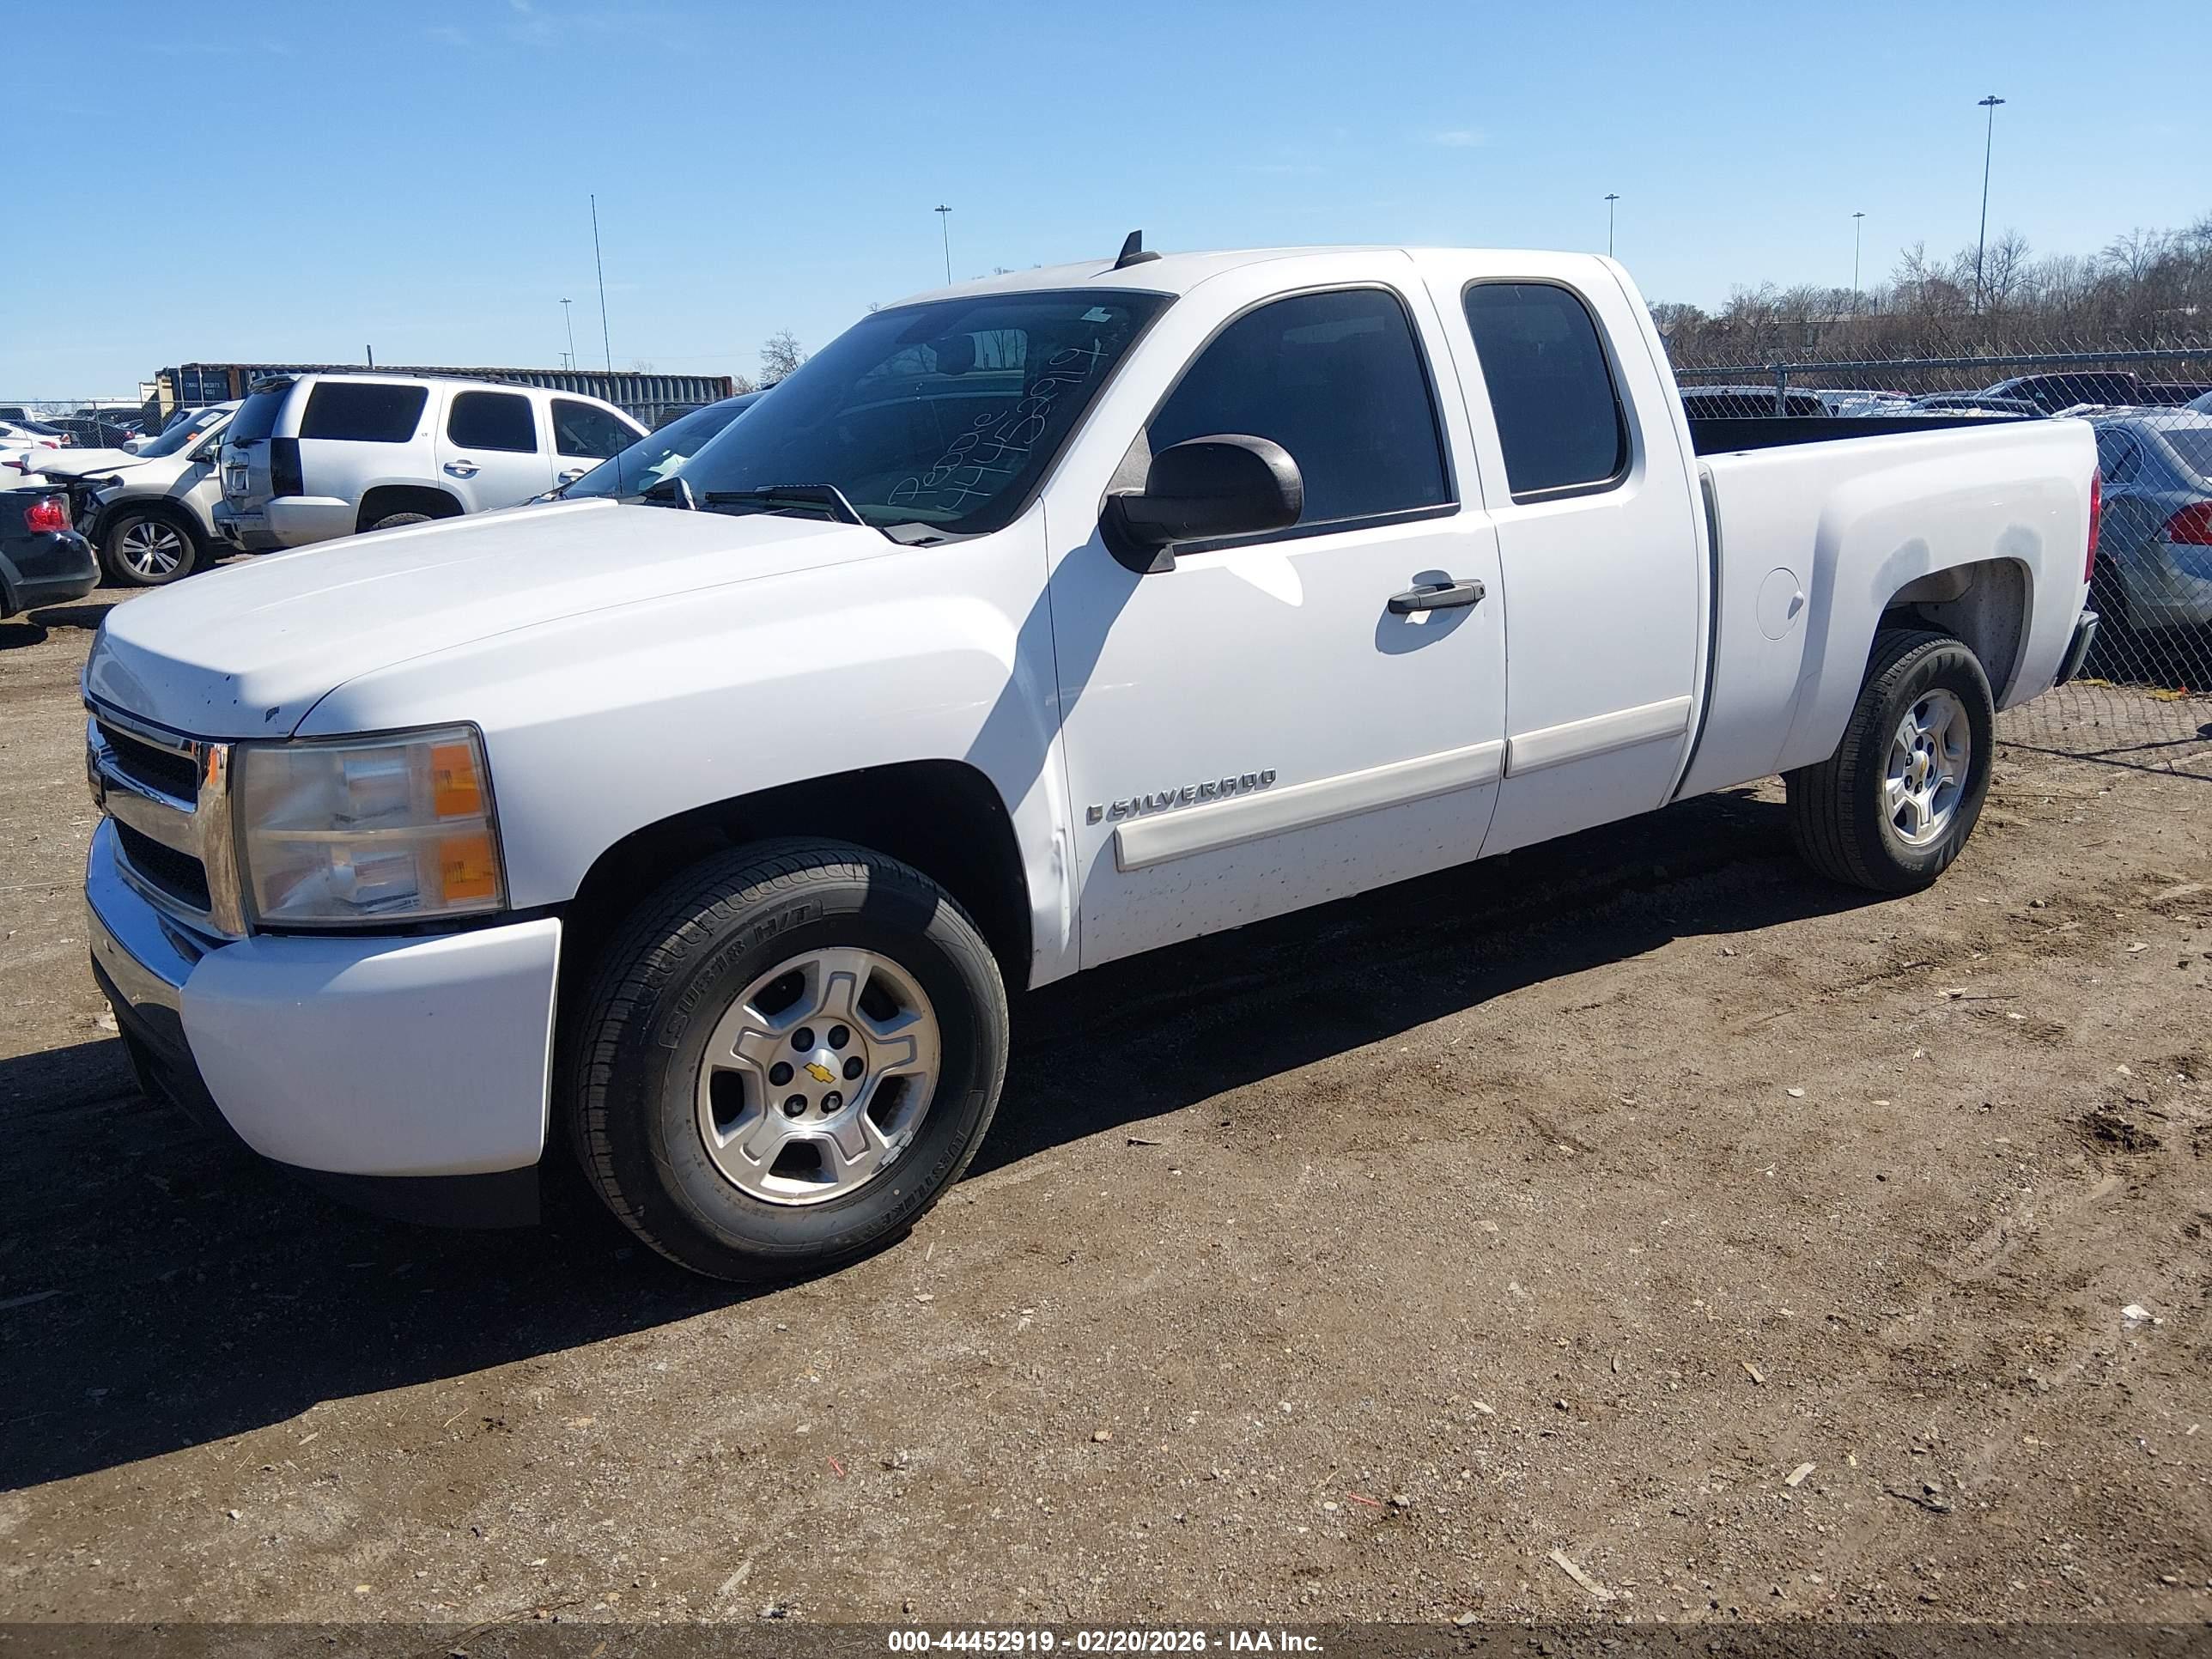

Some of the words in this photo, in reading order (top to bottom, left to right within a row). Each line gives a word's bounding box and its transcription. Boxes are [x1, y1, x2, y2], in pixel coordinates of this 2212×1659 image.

[933, 348, 1109, 511] 44452919
[1113, 767, 1277, 817] SILVERADO
[752, 904, 811, 944] H/T
